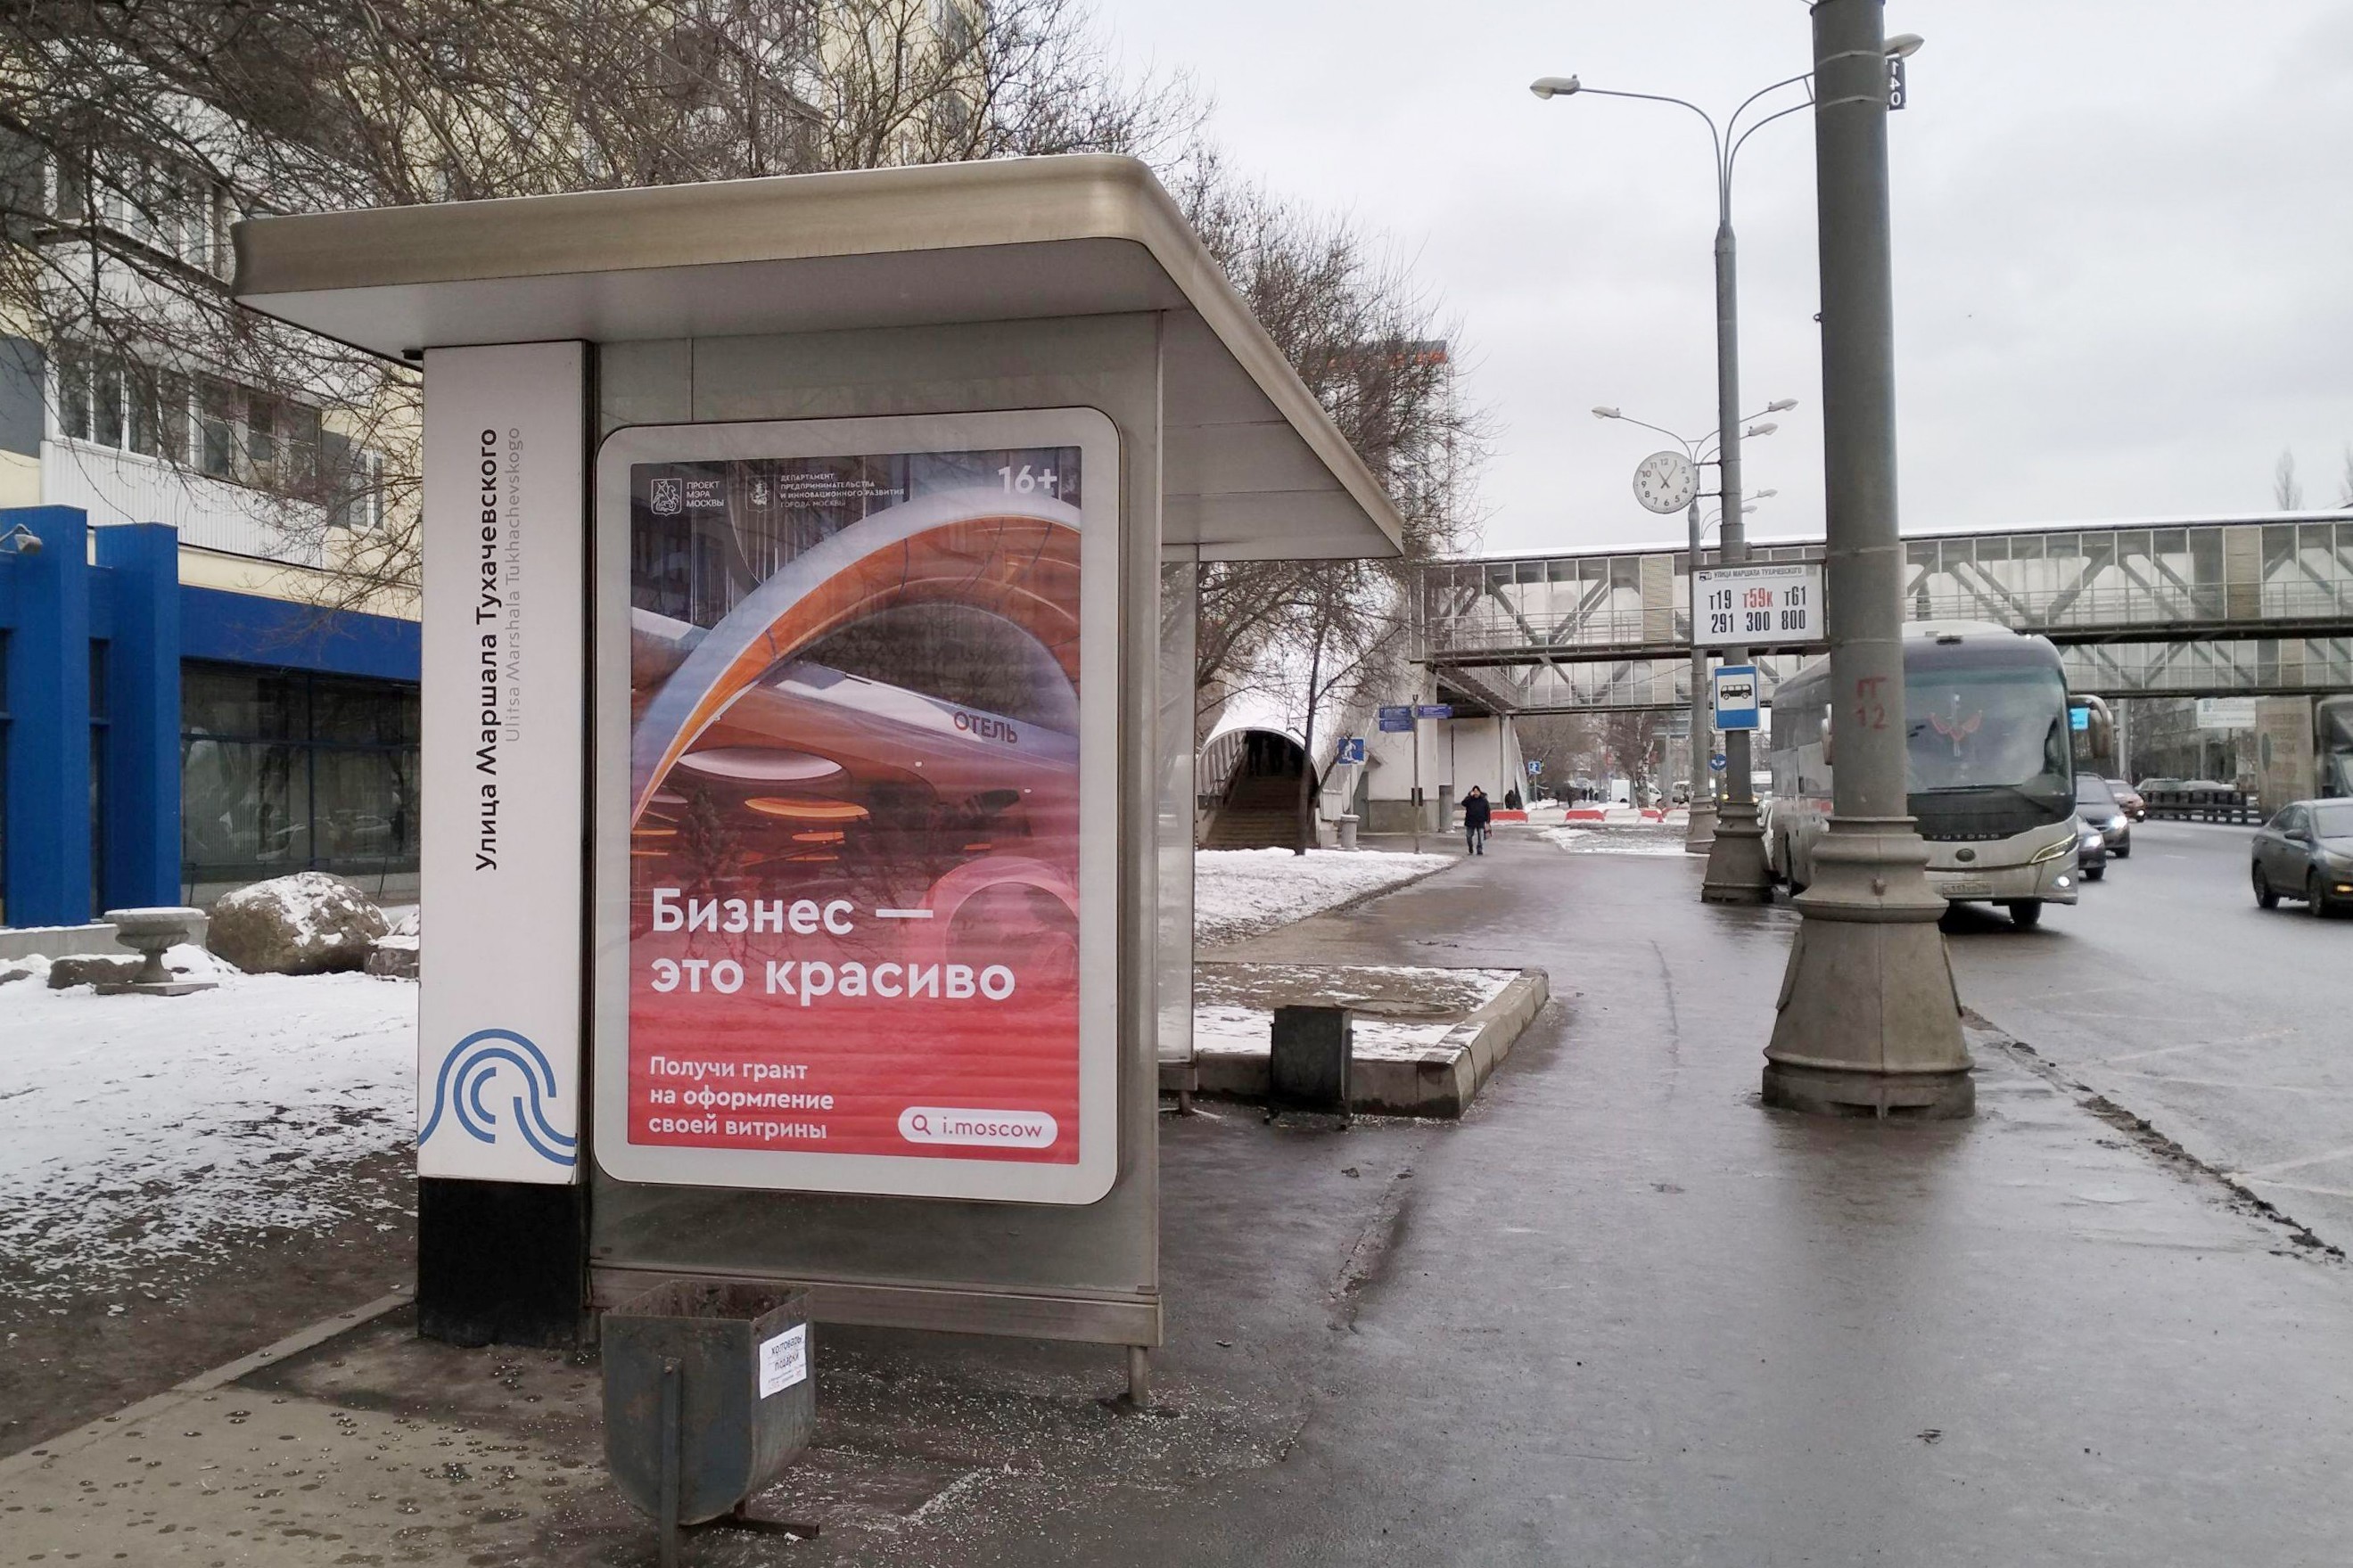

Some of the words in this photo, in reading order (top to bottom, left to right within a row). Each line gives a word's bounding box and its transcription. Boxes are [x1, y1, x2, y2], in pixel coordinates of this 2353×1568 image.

[687, 480, 720, 489] ПРОЕКТ
[780, 473, 835, 482] ДЕПАРТАМЕНТ
[780, 480, 876, 490] ПРЕДПРИНИМАТЕЛЬСТВА
[998, 465, 1057, 494] 16+
[505, 427, 522, 586] Tukhachevskogo
[687, 490, 711, 498] МЭРА
[687, 499, 725, 507] МОСКВЫ
[788, 490, 863, 499] ИННОВАЦИОННОГО
[865, 488, 905, 497] РАЗВИТИЯ
[812, 499, 846, 507] МОСКВЫ
[476, 429, 501, 626] Тухачевского
[1711, 612, 1733, 634] 291
[1746, 611, 1770, 632] 300
[1781, 609, 1806, 630] 800
[505, 590, 520, 681] Marshala
[476, 634, 501, 776] Маршала
[505, 686, 520, 743] Ulitsa
[1855, 703, 1889, 729] 12
[954, 711, 1018, 743] ОТЕЛЬ
[476, 784, 499, 872] Улица
[652, 887, 853, 935] Бизнес
[650, 957, 744, 995] это
[766, 959, 1016, 1006] красиво
[649, 1055, 735, 1080] Получи
[743, 1063, 808, 1082] грант
[649, 1088, 676, 1104] на
[683, 1084, 835, 1111] оформление
[648, 1113, 718, 1135] своей
[725, 1121, 827, 1141] витрины
[942, 1116, 1042, 1137] i.moscow
